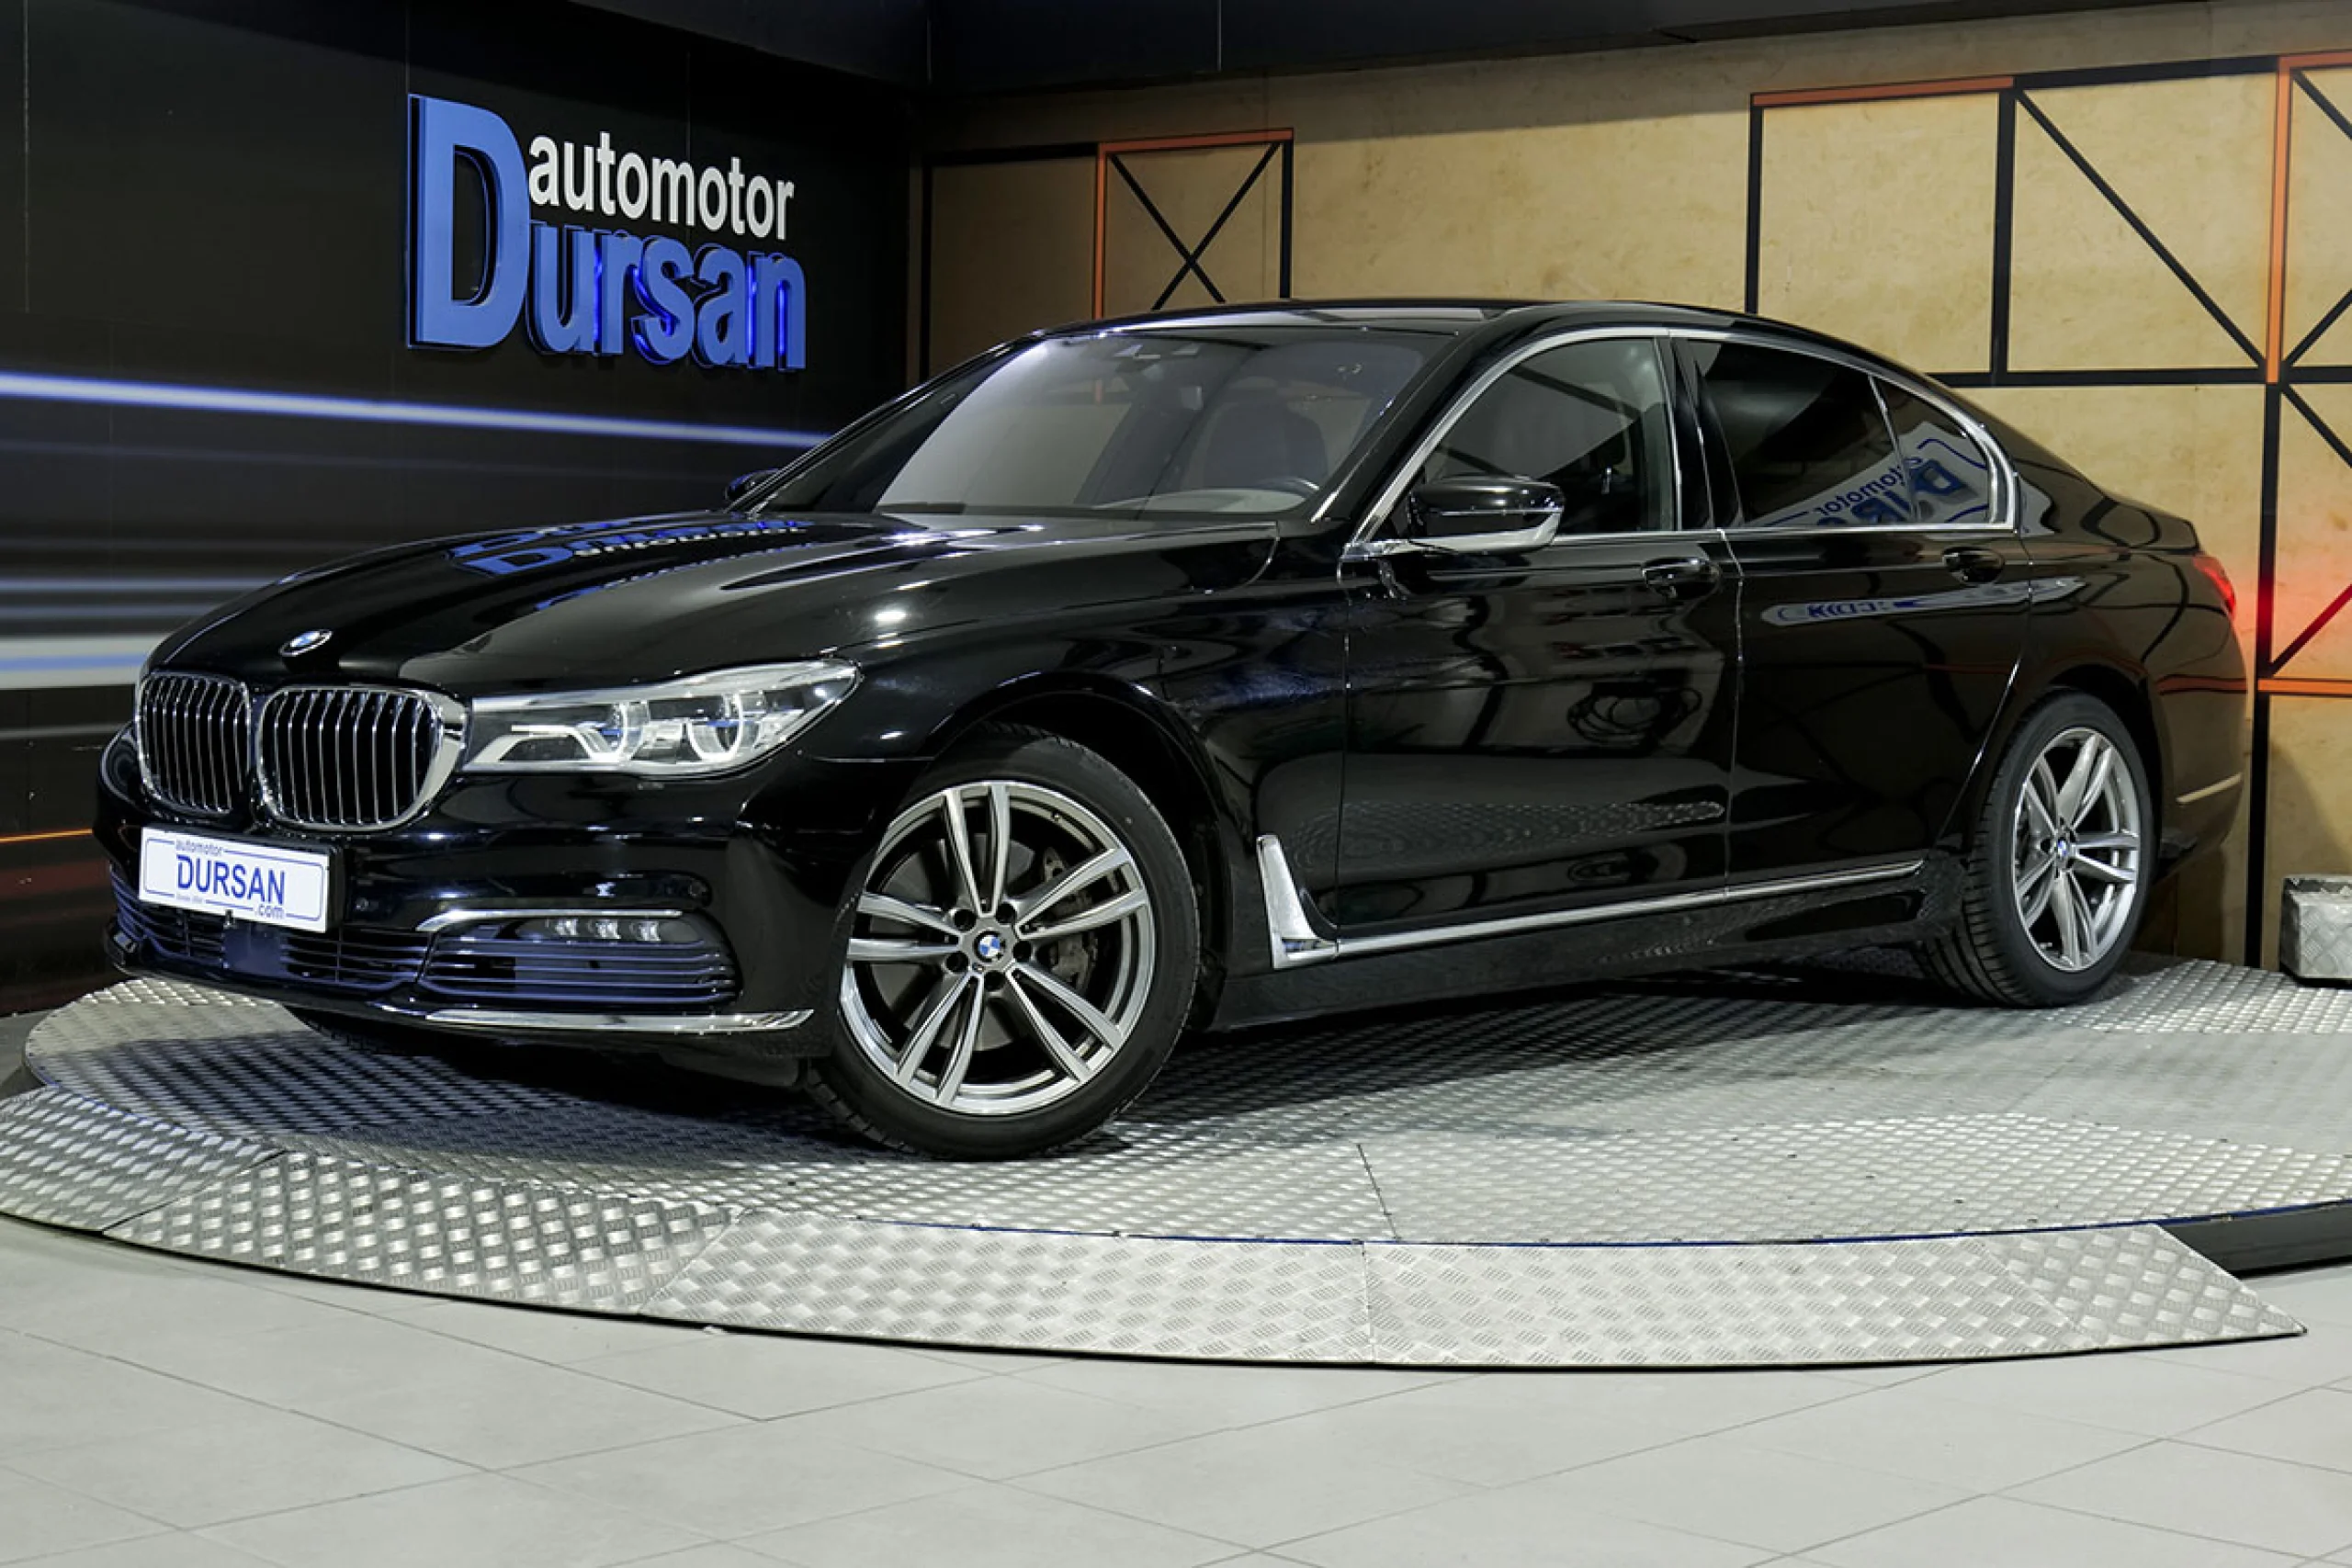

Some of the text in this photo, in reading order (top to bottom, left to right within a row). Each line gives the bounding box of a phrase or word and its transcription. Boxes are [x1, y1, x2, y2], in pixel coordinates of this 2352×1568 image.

[408, 93, 806, 371] Dursan
[528, 131, 795, 240] automotor
[176, 853, 286, 906] DURSAN
